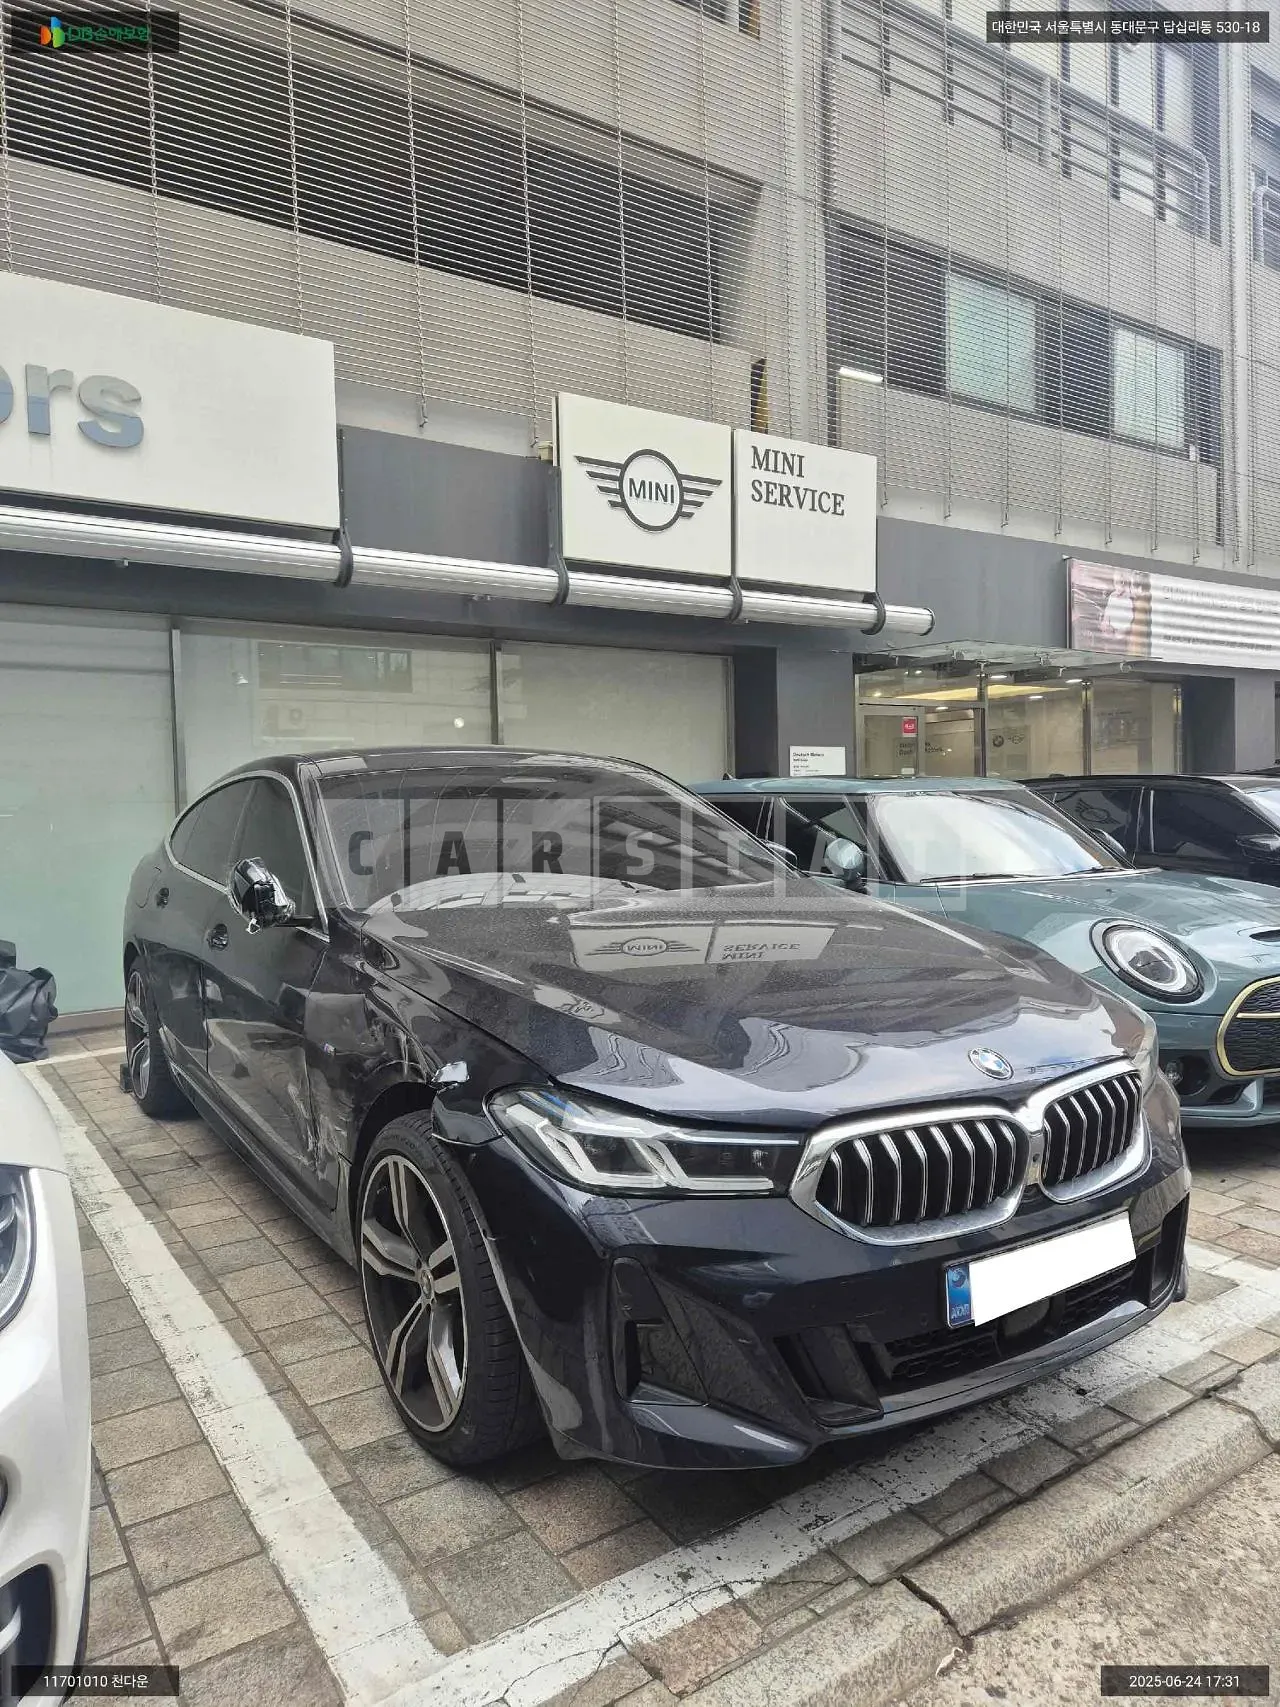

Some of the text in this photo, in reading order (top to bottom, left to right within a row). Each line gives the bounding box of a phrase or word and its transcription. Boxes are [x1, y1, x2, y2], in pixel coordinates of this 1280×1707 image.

[0, 362, 145, 449] rs
[751, 445, 805, 478] MINI
[628, 477, 675, 504] MINI
[751, 479, 845, 516] SERVICE
